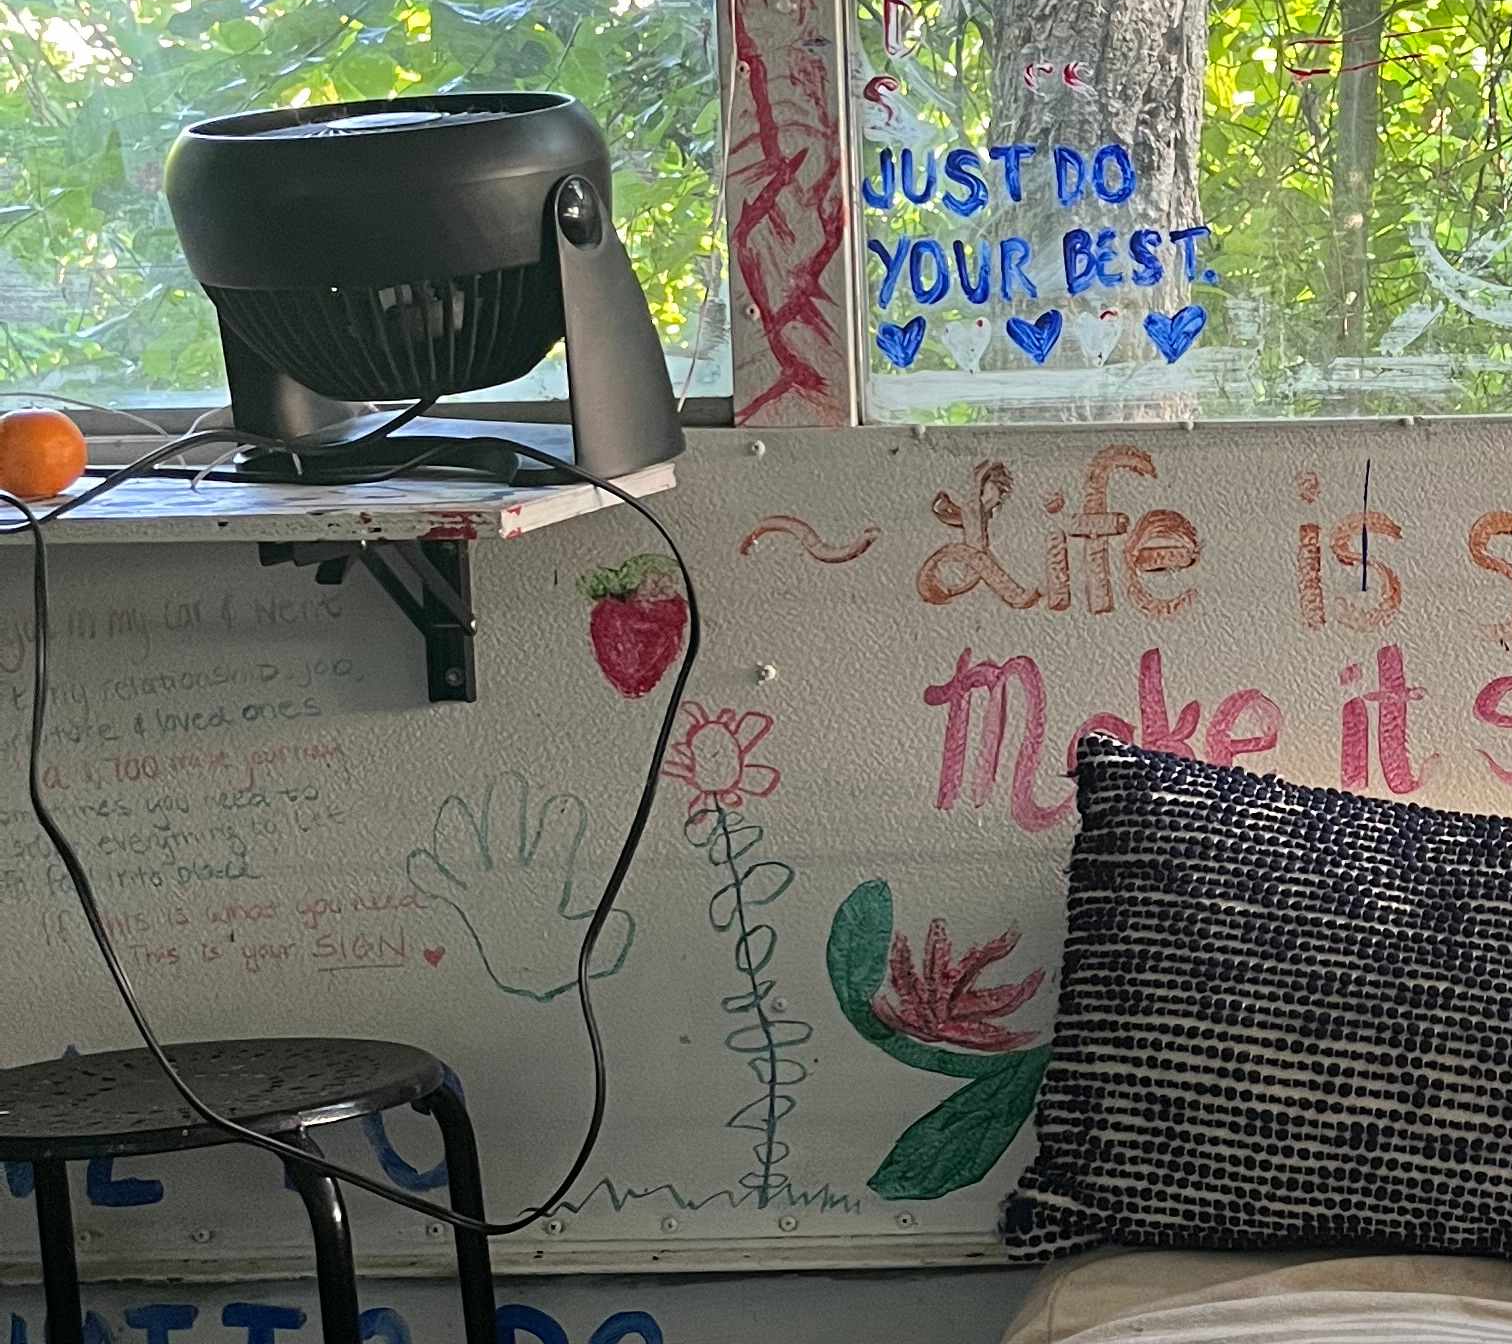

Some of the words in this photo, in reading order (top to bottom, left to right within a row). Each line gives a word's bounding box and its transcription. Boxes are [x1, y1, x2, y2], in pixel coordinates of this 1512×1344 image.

[863, 144, 1037, 217] JUST
[1056, 143, 1137, 207] DO
[866, 233, 1038, 310] YOUR
[916, 443, 1201, 618] Life
[1298, 471, 1403, 632] is
[1338, 643, 1440, 795] it
